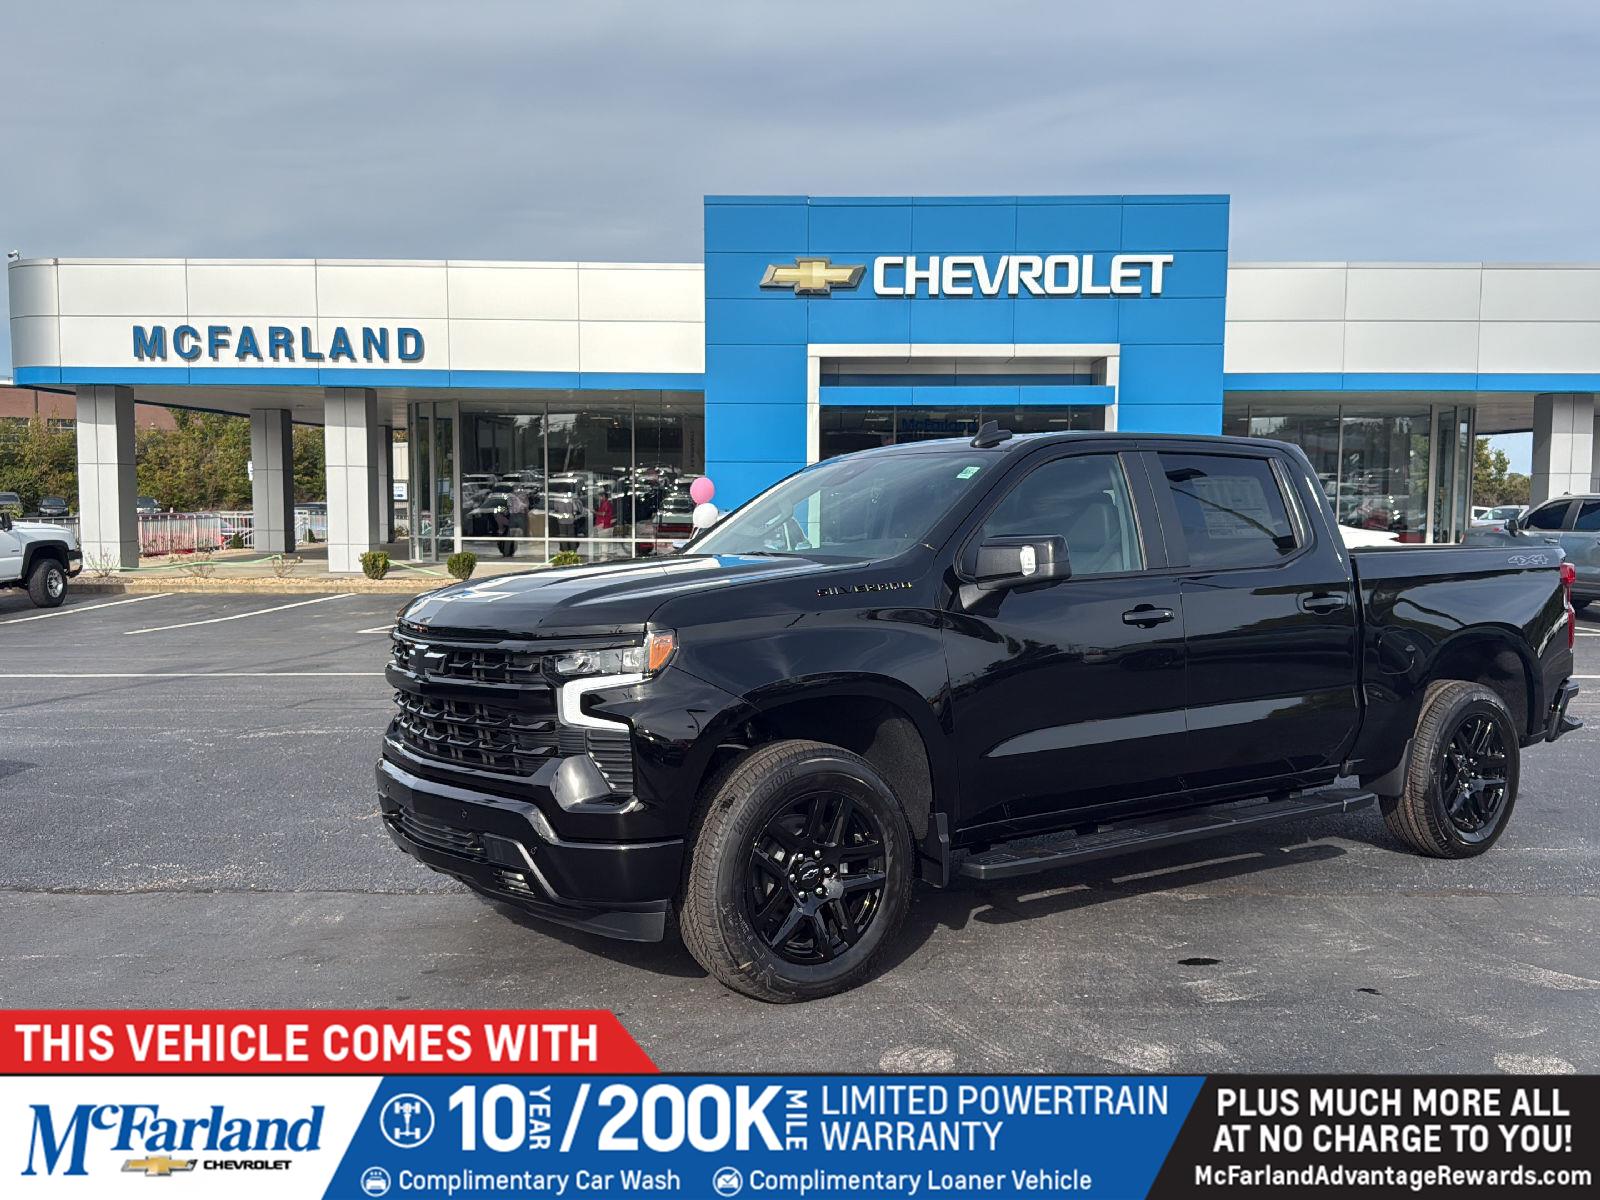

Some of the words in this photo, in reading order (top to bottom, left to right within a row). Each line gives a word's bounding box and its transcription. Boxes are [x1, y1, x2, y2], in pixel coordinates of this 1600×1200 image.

[873, 254, 1174, 295] CHEVROLET
[132, 325, 425, 361] MCFARLAND
[816, 582, 913, 597] SILVERADO
